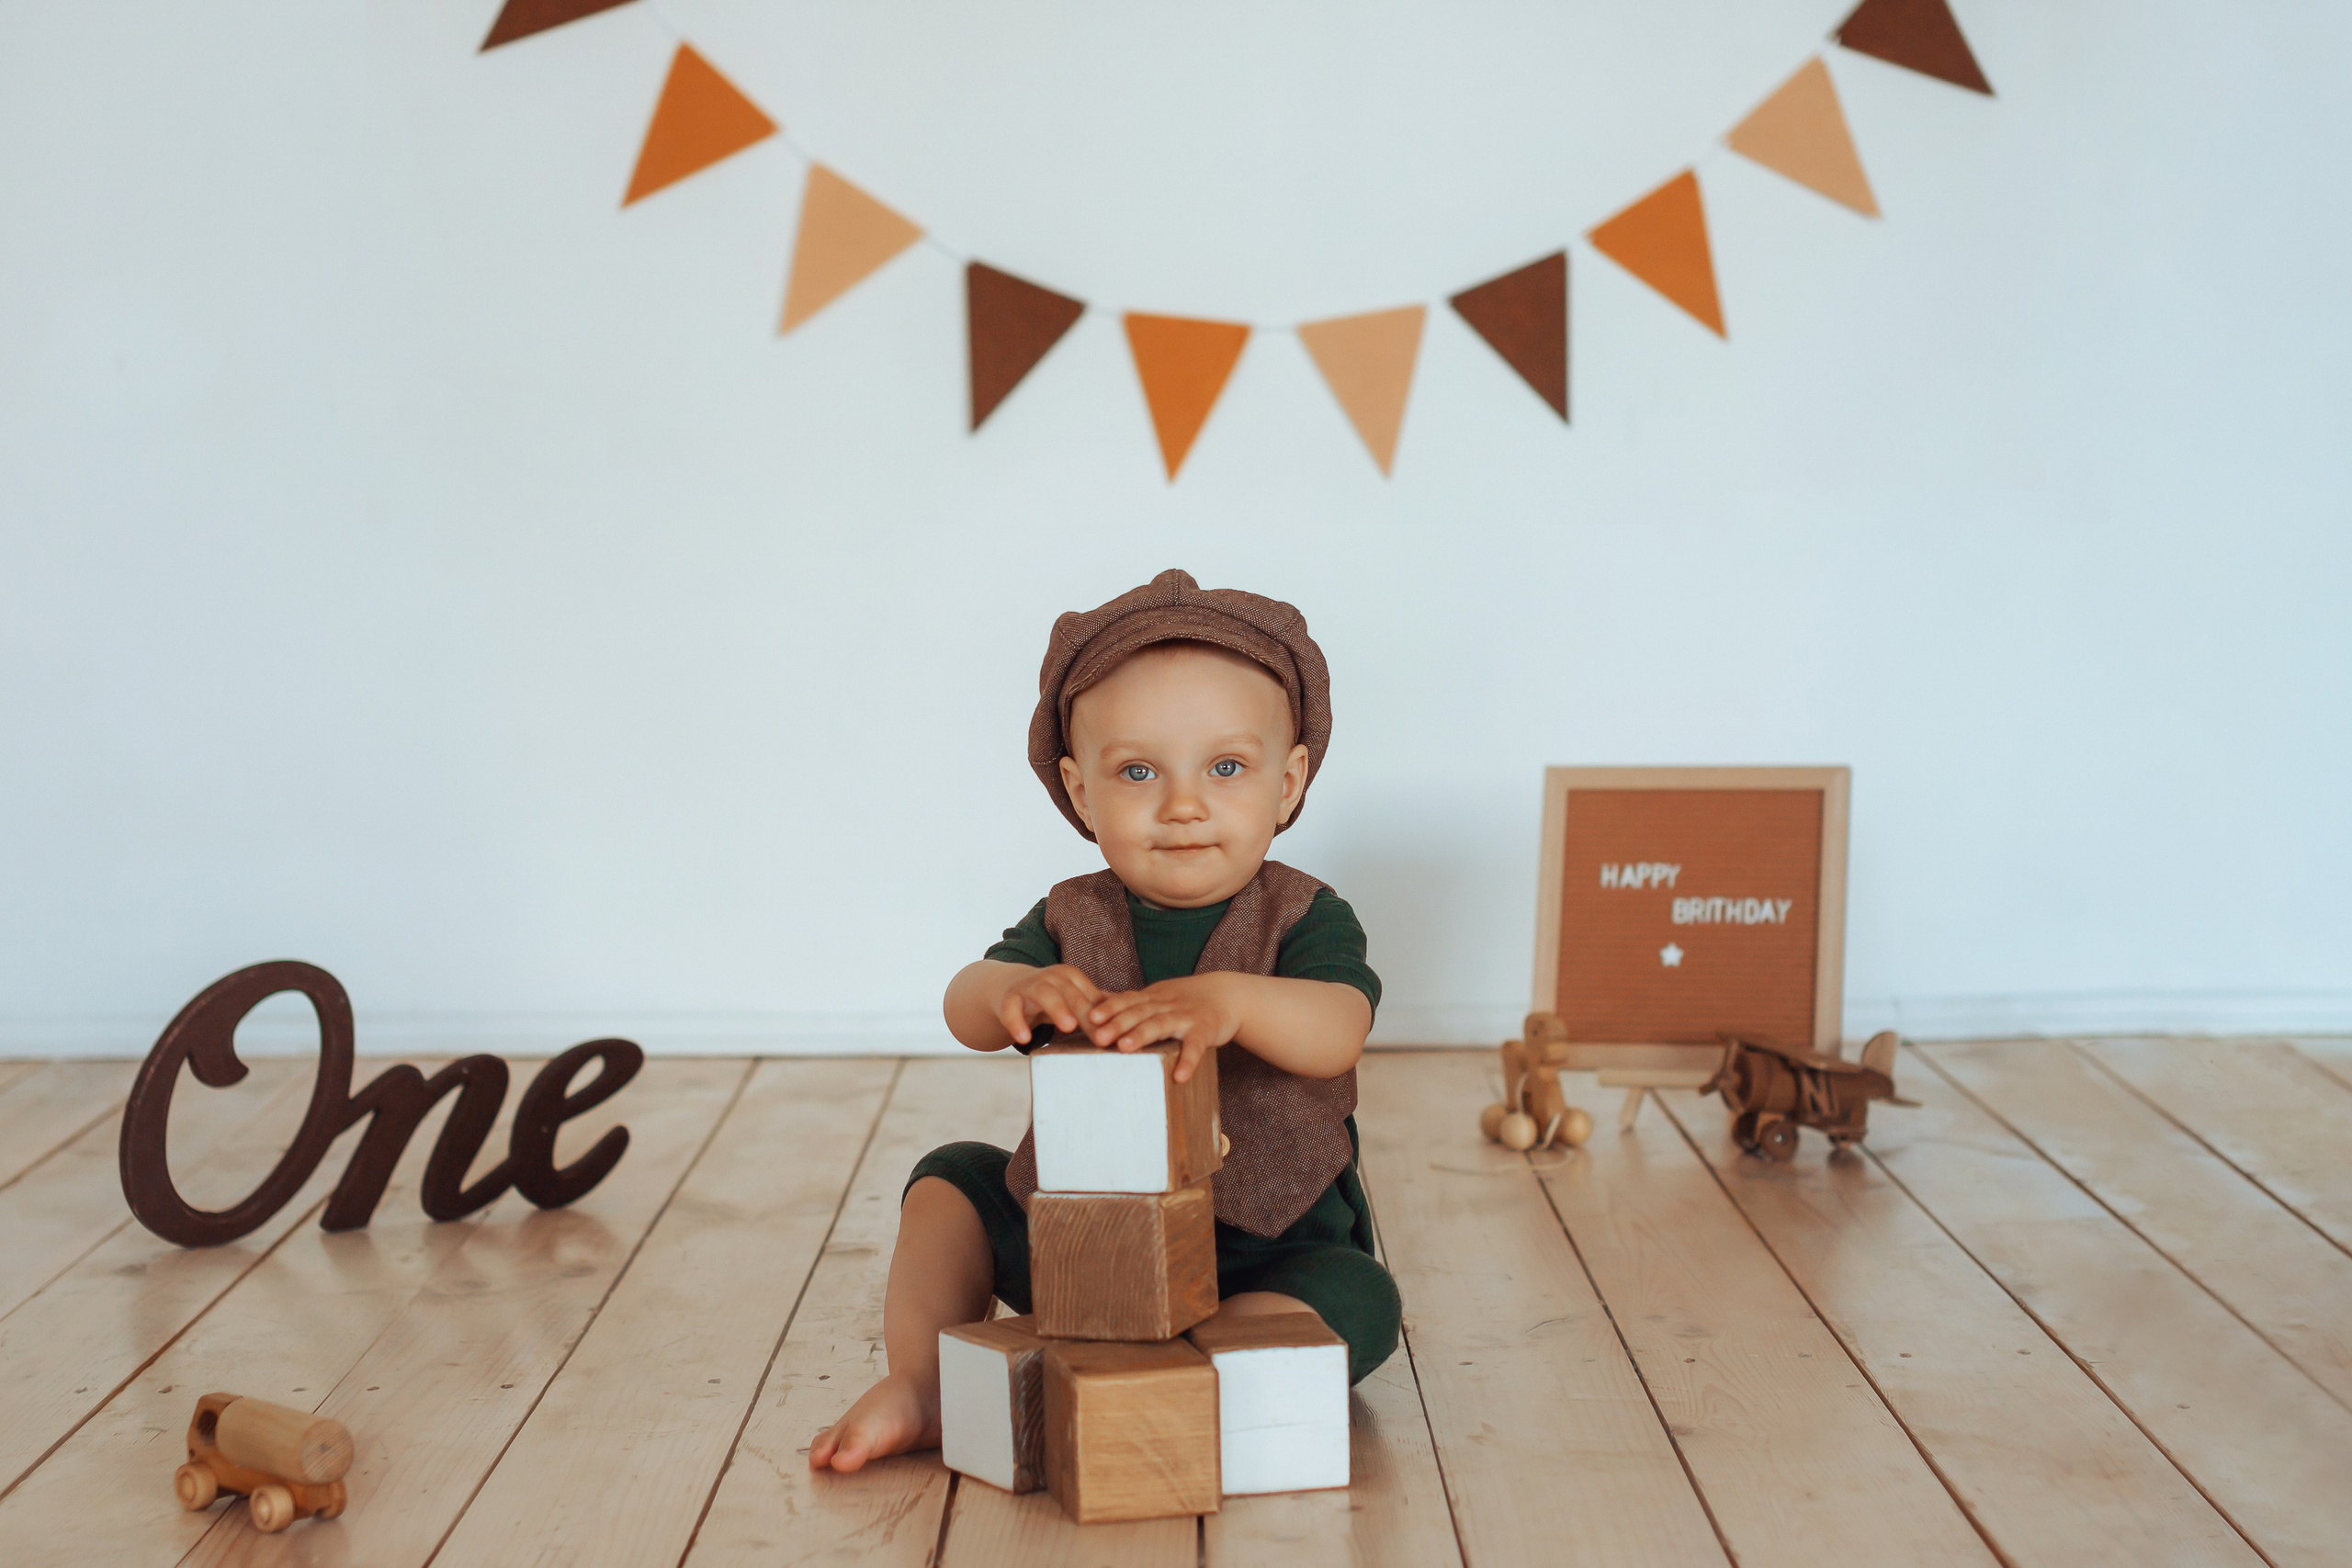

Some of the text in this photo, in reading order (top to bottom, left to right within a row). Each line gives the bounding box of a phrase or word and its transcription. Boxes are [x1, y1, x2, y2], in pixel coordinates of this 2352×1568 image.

[1600, 862, 1681, 889] HAPPY
[1671, 897, 1792, 925] BRITHDAY
[119, 960, 645, 1249] One
